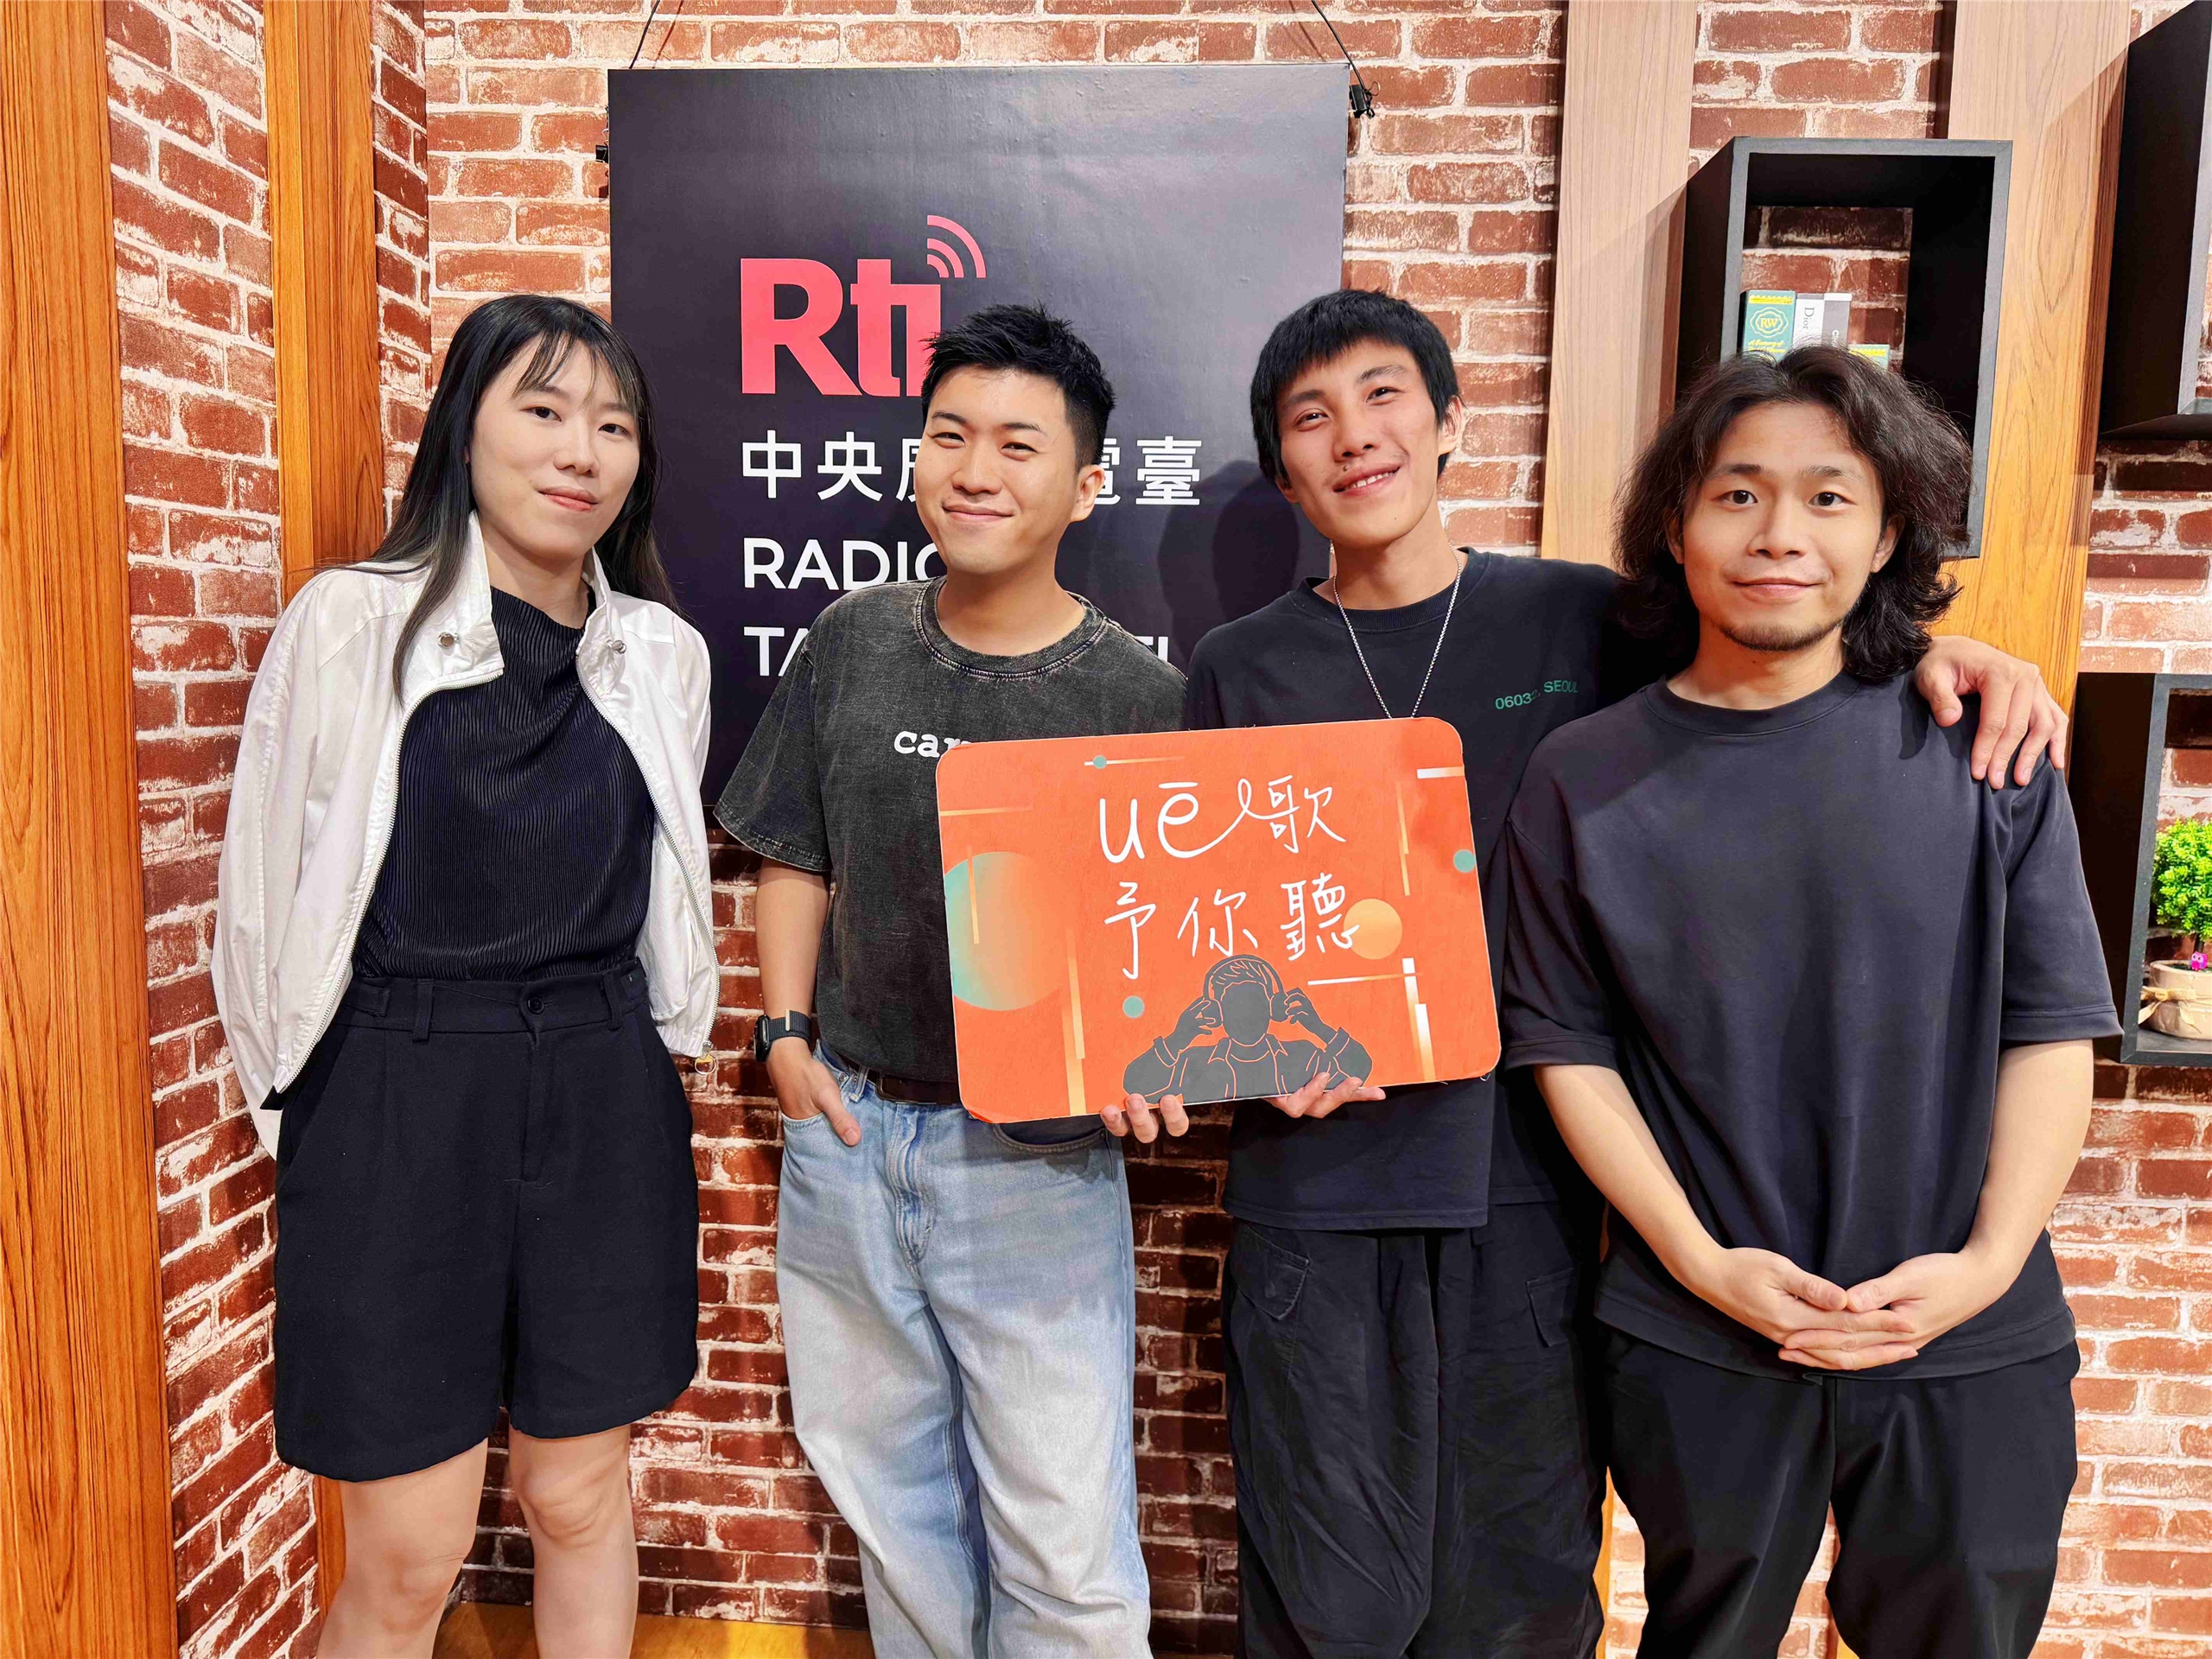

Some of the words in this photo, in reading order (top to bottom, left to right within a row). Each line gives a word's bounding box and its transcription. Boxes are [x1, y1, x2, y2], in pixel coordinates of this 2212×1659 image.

[1760, 317, 1779, 328] RW
[1802, 307, 1815, 330] Dior
[741, 429, 1203, 506] 中央臺
[1543, 680, 1579, 693] SEOUL
